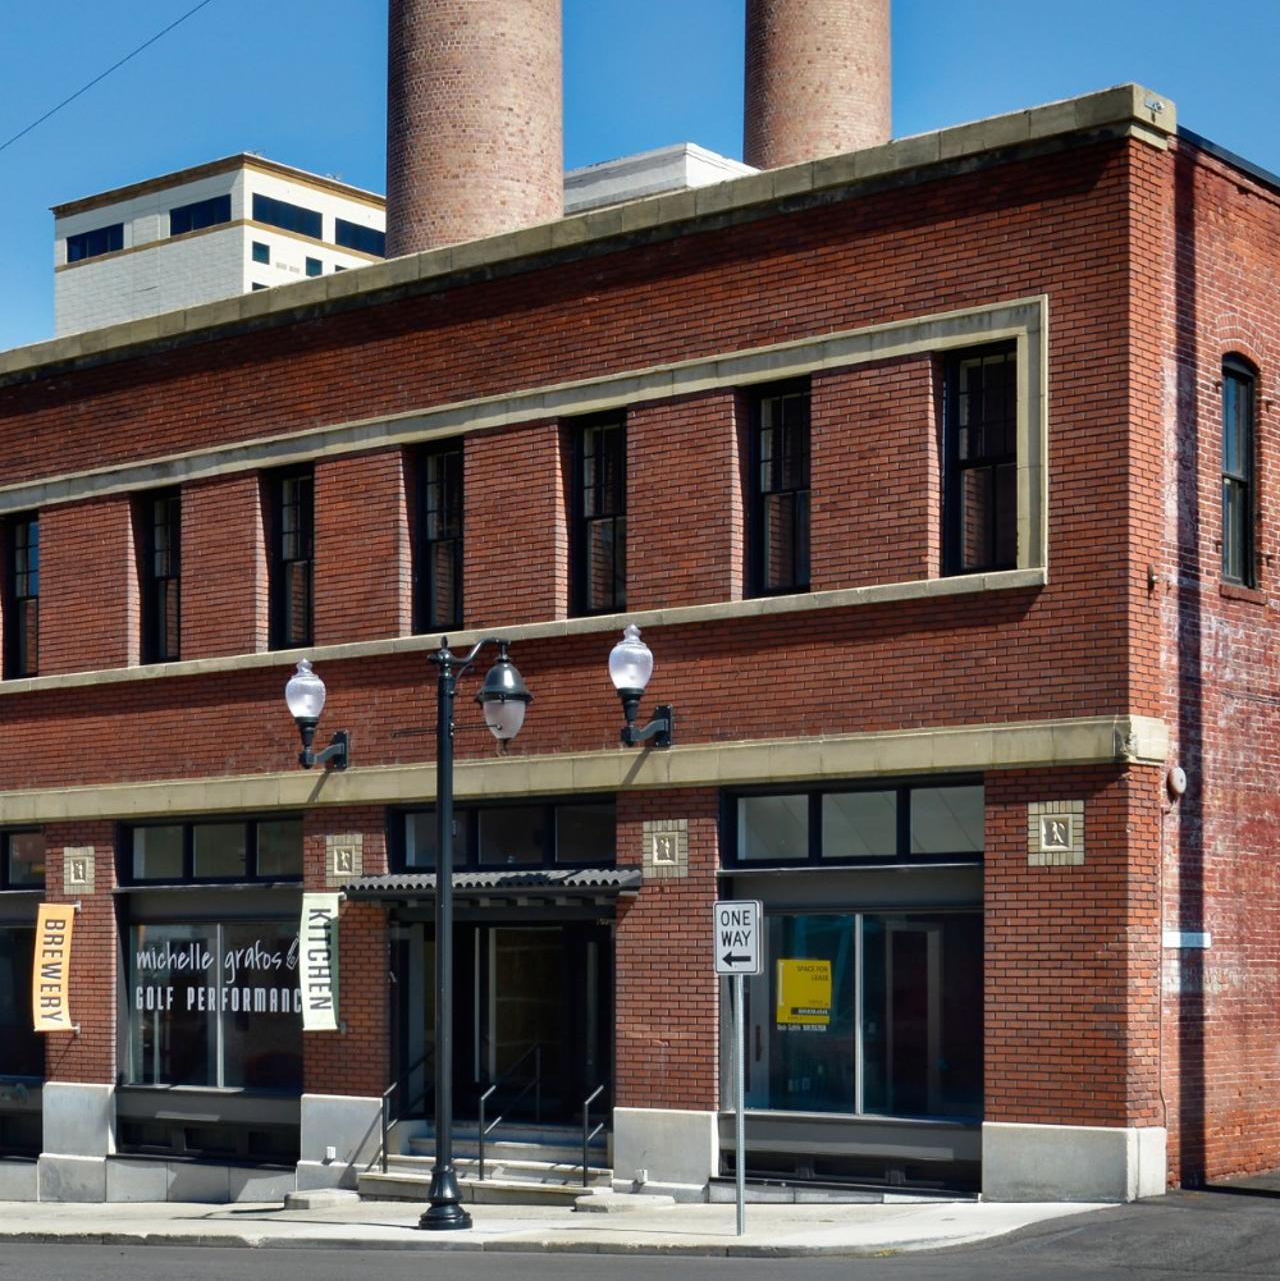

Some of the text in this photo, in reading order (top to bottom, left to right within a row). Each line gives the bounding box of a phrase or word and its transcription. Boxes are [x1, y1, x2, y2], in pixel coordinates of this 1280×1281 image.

[720, 910, 751, 926] ONE
[721, 930, 752, 947] WAY
[136, 940, 214, 970] michelle
[307, 908, 332, 1010] KITCHEN
[40, 918, 66, 1022] BREWERY
[136, 986, 302, 1013] GOLF PERFORMANC
